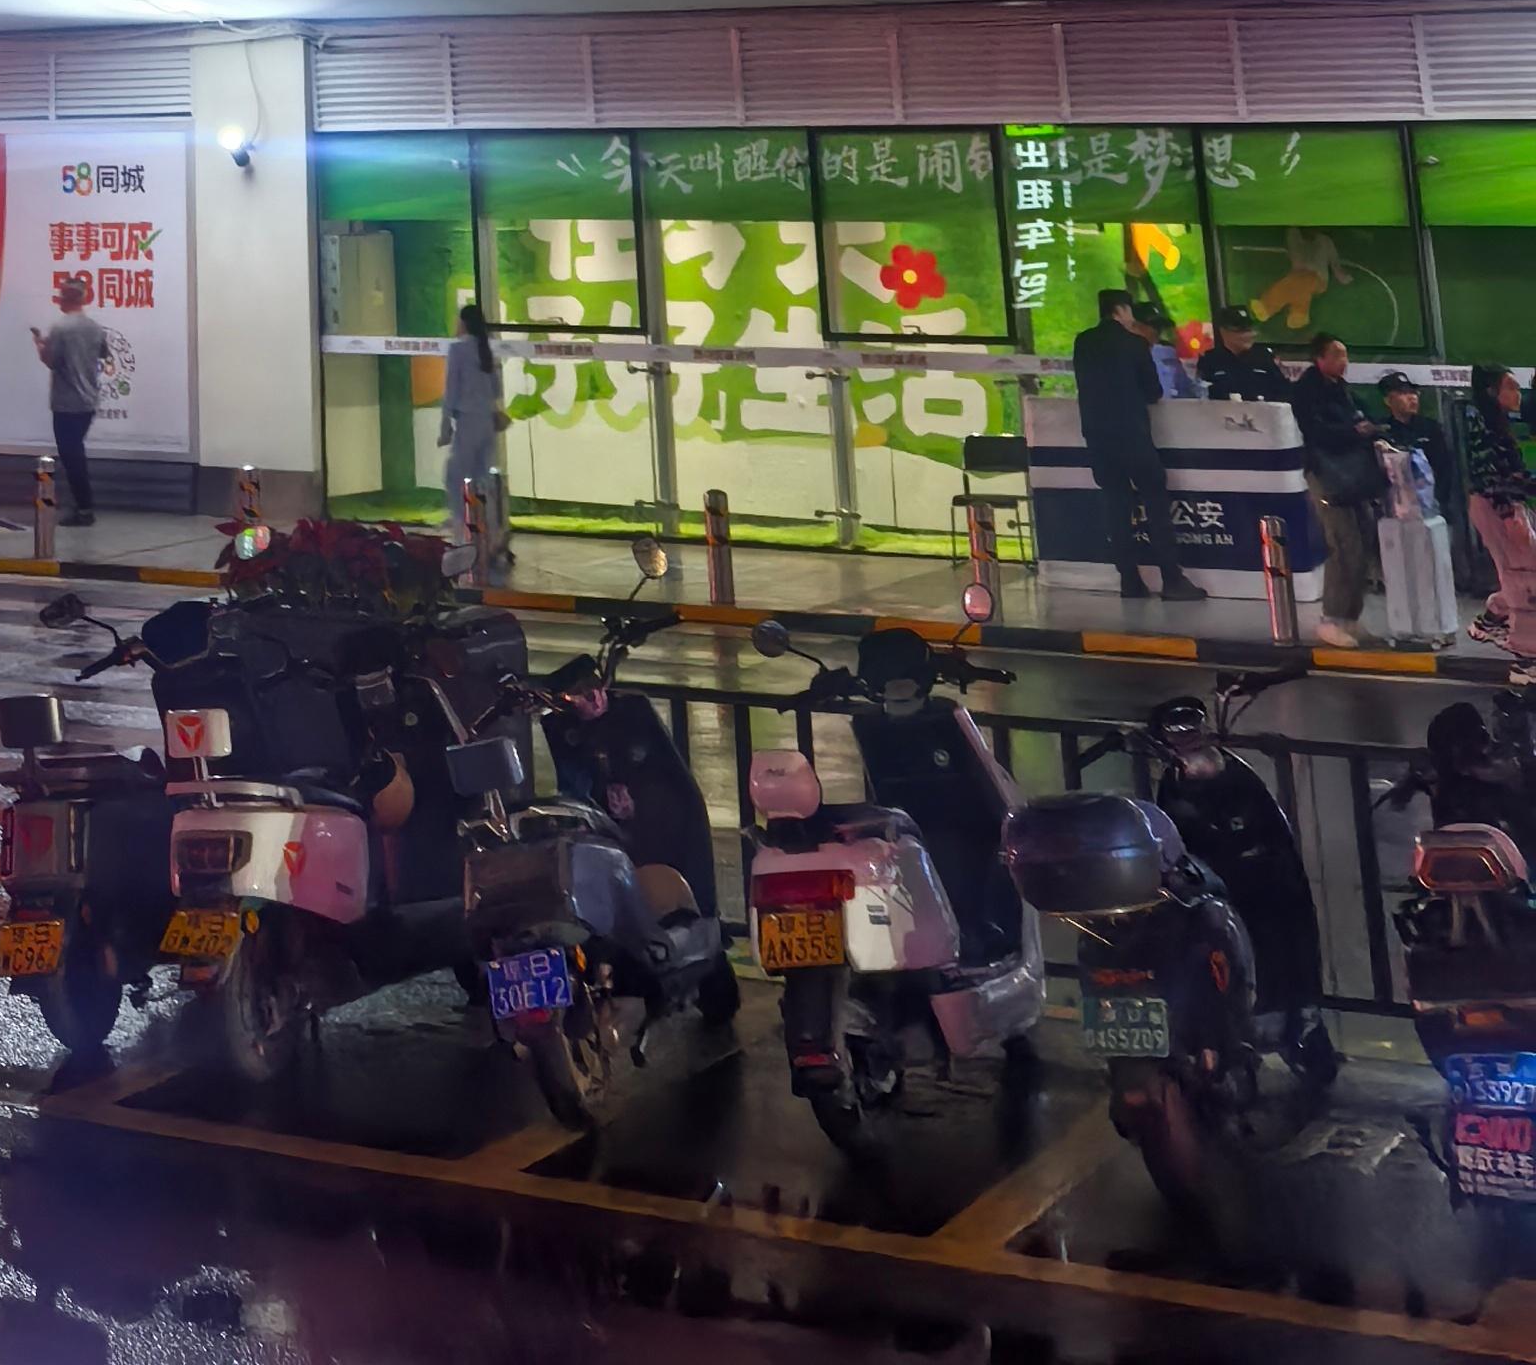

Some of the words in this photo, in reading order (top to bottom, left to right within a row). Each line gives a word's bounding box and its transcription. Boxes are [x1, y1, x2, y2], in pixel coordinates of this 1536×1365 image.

[62, 161, 146, 197] 58同城
[49, 221, 155, 261] 事事可成
[1170, 500, 1225, 528] 公安
